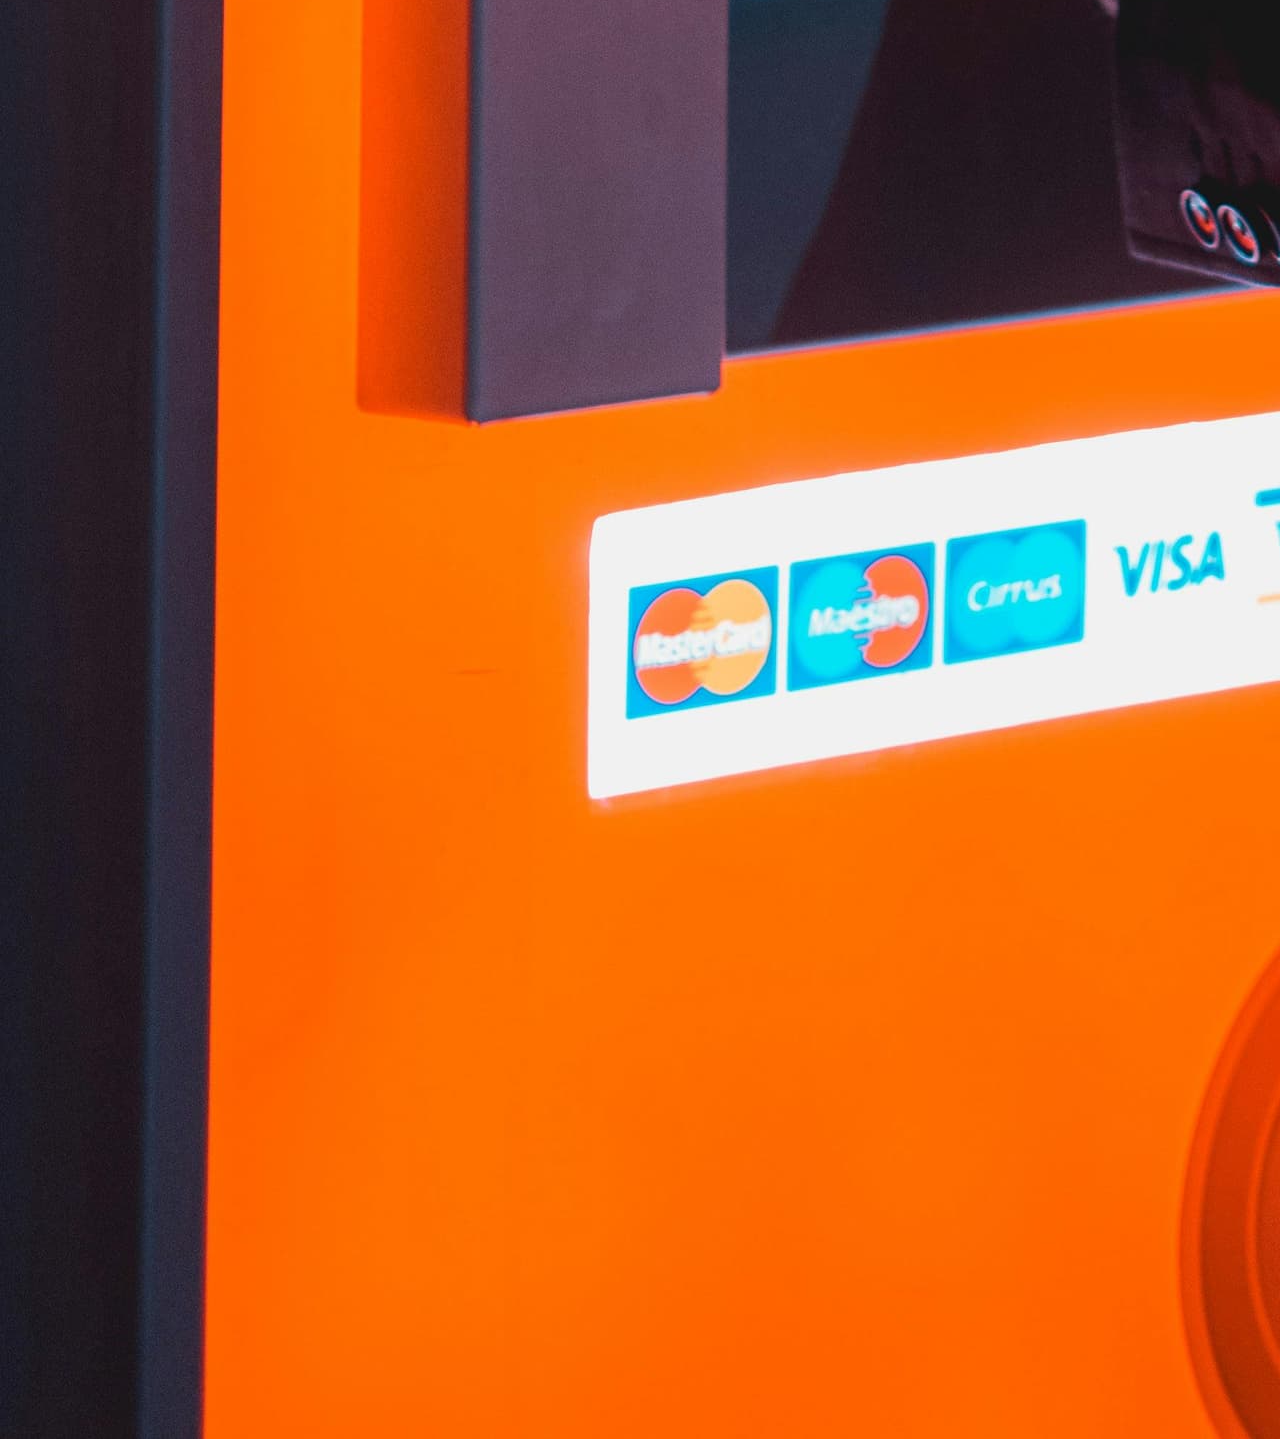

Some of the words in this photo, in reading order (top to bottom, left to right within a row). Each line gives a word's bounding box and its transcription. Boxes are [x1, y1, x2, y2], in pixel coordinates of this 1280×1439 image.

[1114, 531, 1226, 597] VISA
[807, 592, 921, 638] Maestro
[965, 572, 1064, 613] Cirrus
[634, 613, 771, 671] MasterCard
